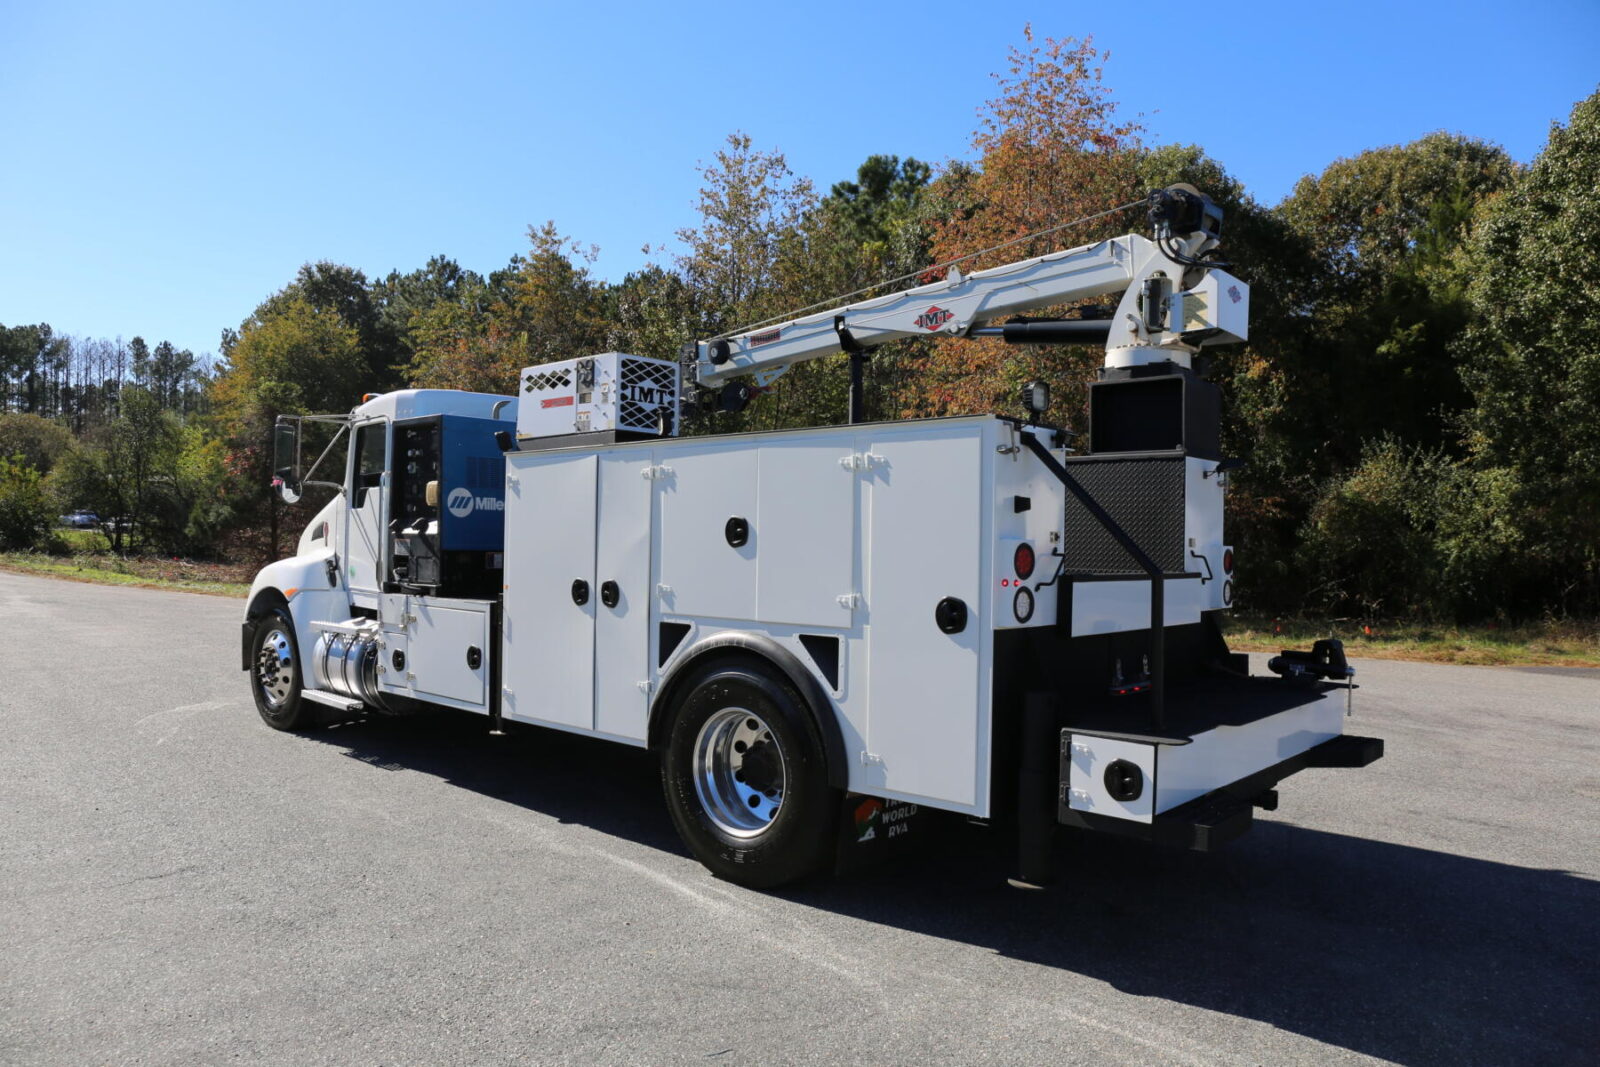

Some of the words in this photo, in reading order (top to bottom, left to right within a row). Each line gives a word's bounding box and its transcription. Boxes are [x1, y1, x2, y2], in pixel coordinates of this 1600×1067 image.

[919, 309, 950, 328] IMT
[630, 386, 668, 405] IMT
[475, 496, 505, 511] Mille
[882, 805, 918, 824] WORLD
[888, 822, 908, 838] RVA
